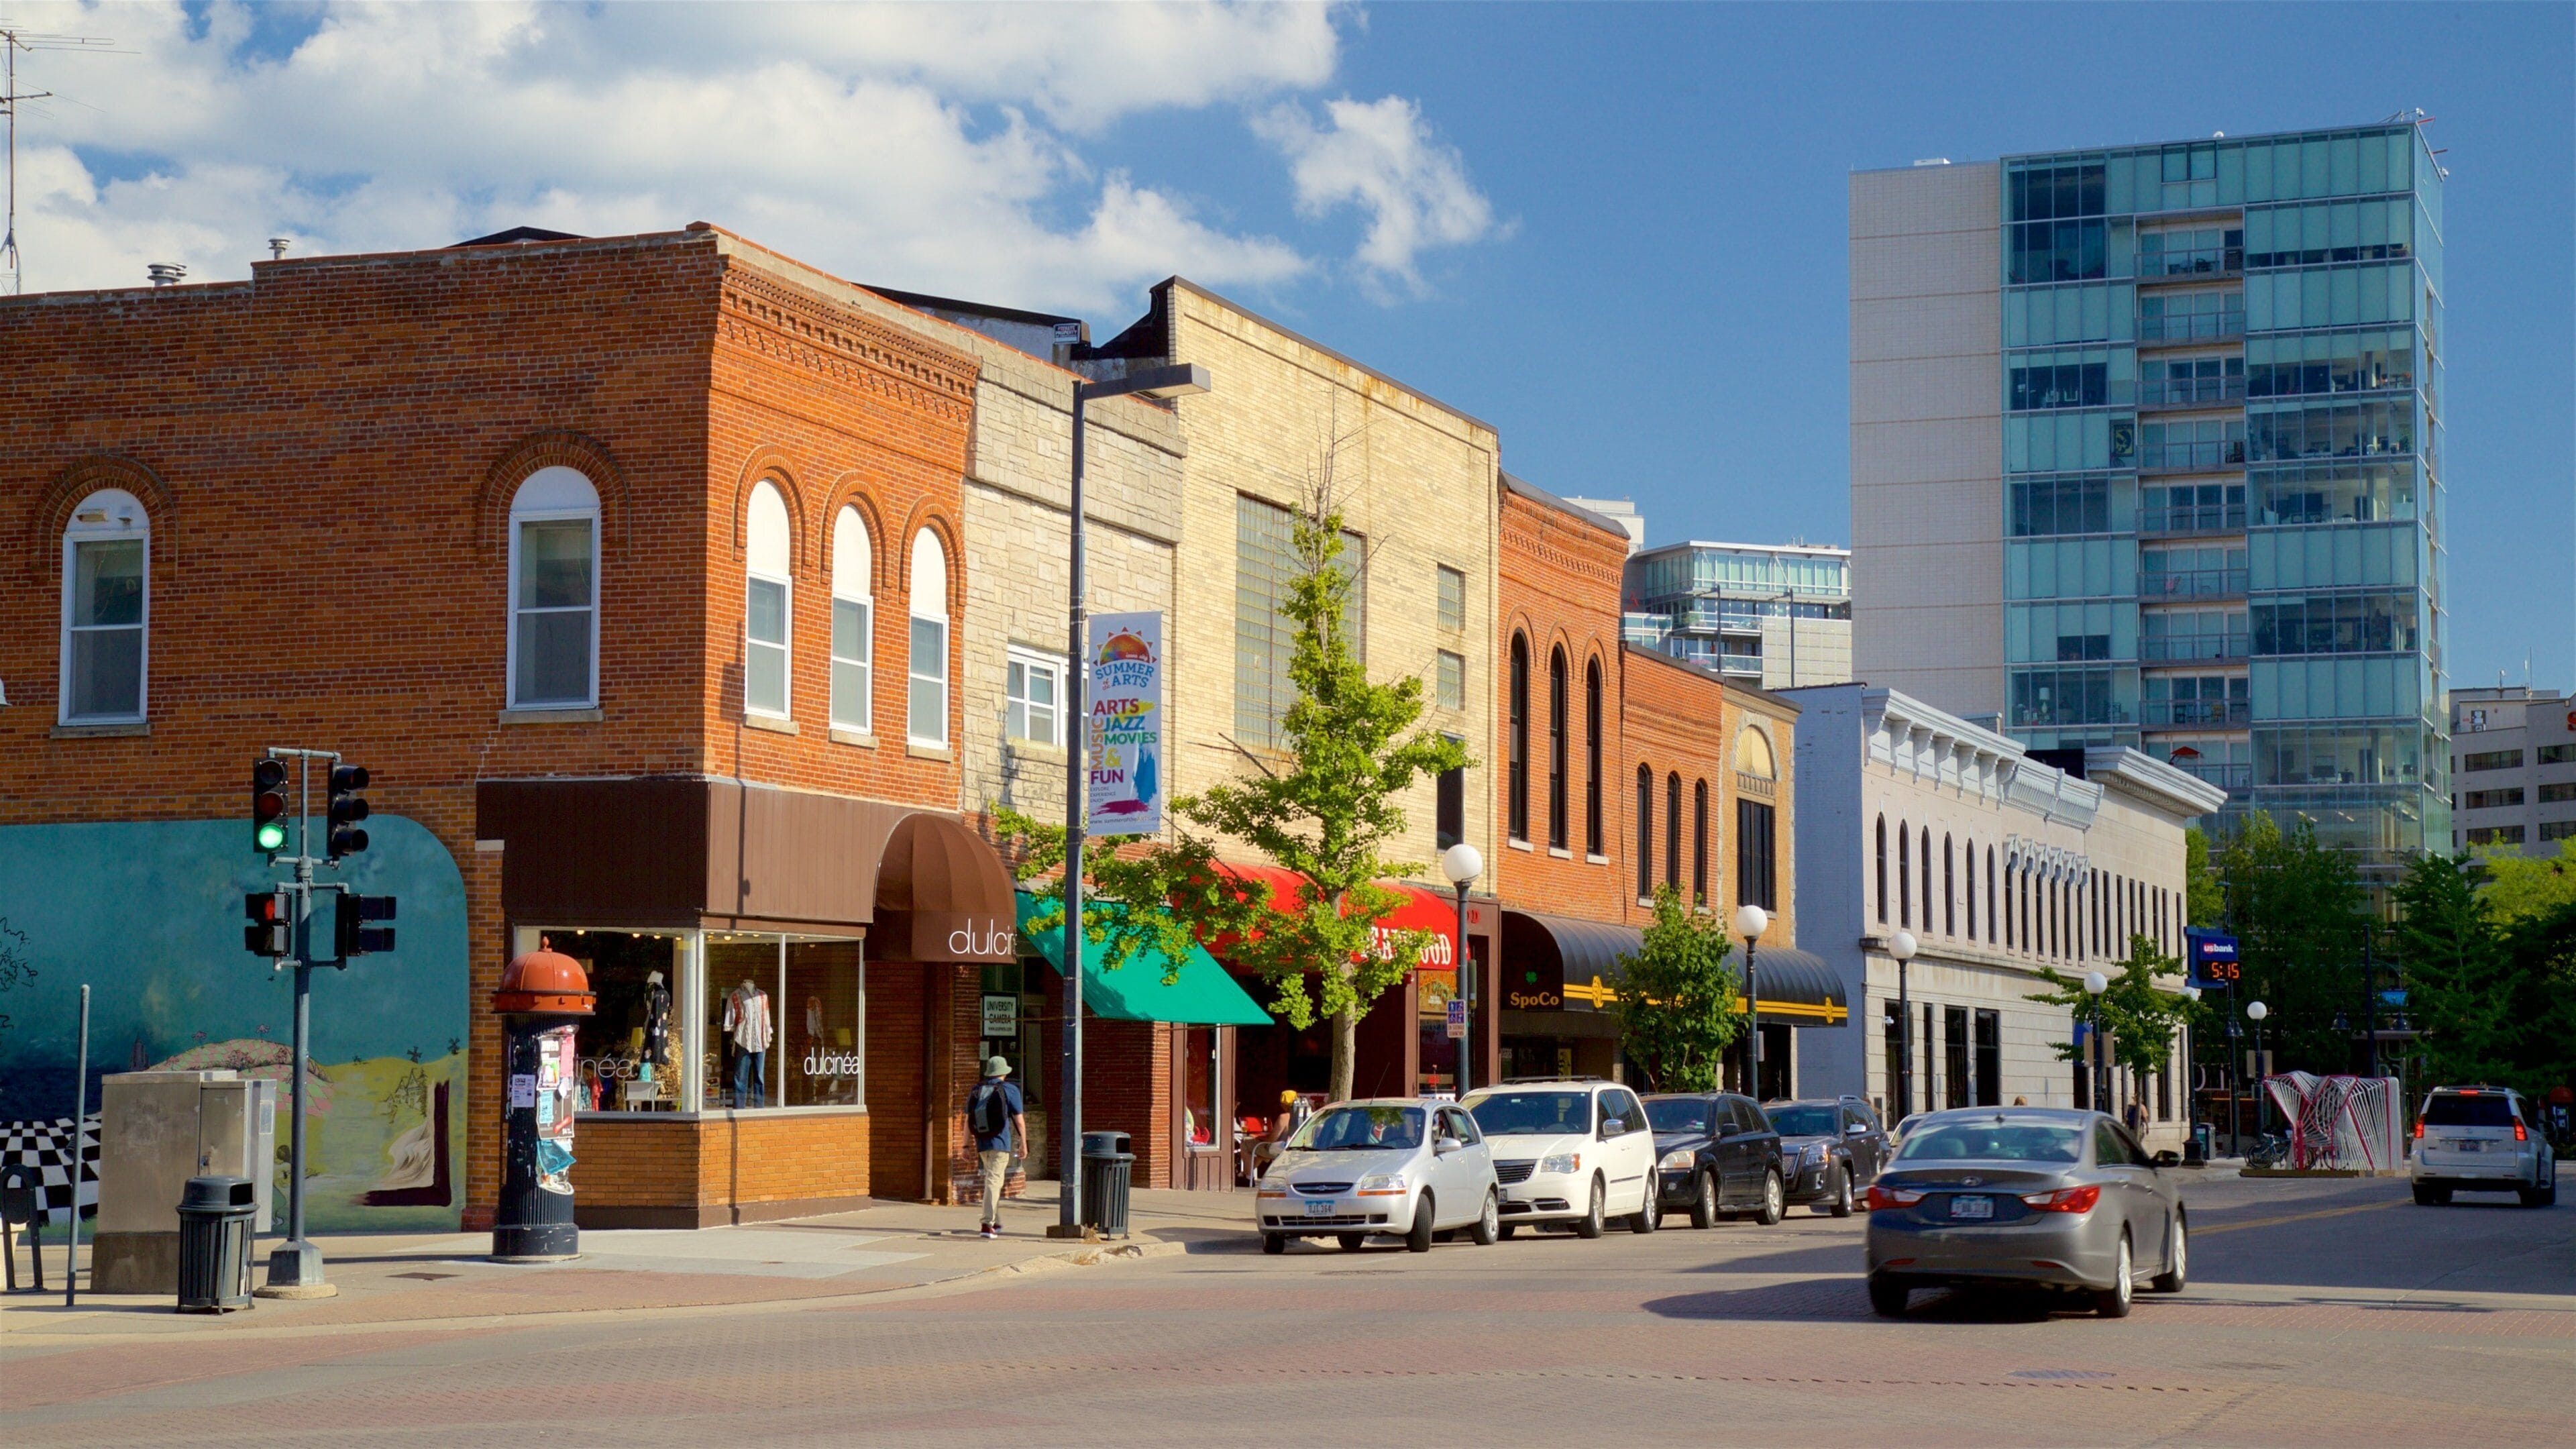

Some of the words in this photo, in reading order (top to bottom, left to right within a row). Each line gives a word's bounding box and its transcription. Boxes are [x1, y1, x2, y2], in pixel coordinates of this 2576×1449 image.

[1095, 662, 1155, 680] SUMMER
[1112, 674, 1149, 688] ARTS
[1093, 698, 1139, 716] ARTS
[1104, 716, 1145, 732] JAZZ
[1091, 717, 1104, 771] MUSIC
[1104, 732, 1157, 745] MOVIES
[1104, 747, 1122, 768] &
[1091, 769, 1124, 784] FUN
[2211, 962, 2239, 979] 5:15
[987, 1001, 1014, 1011] UNIVERSITY
[1510, 991, 1559, 1008] SpoCo
[804, 1046, 861, 1075] dulcinéa
